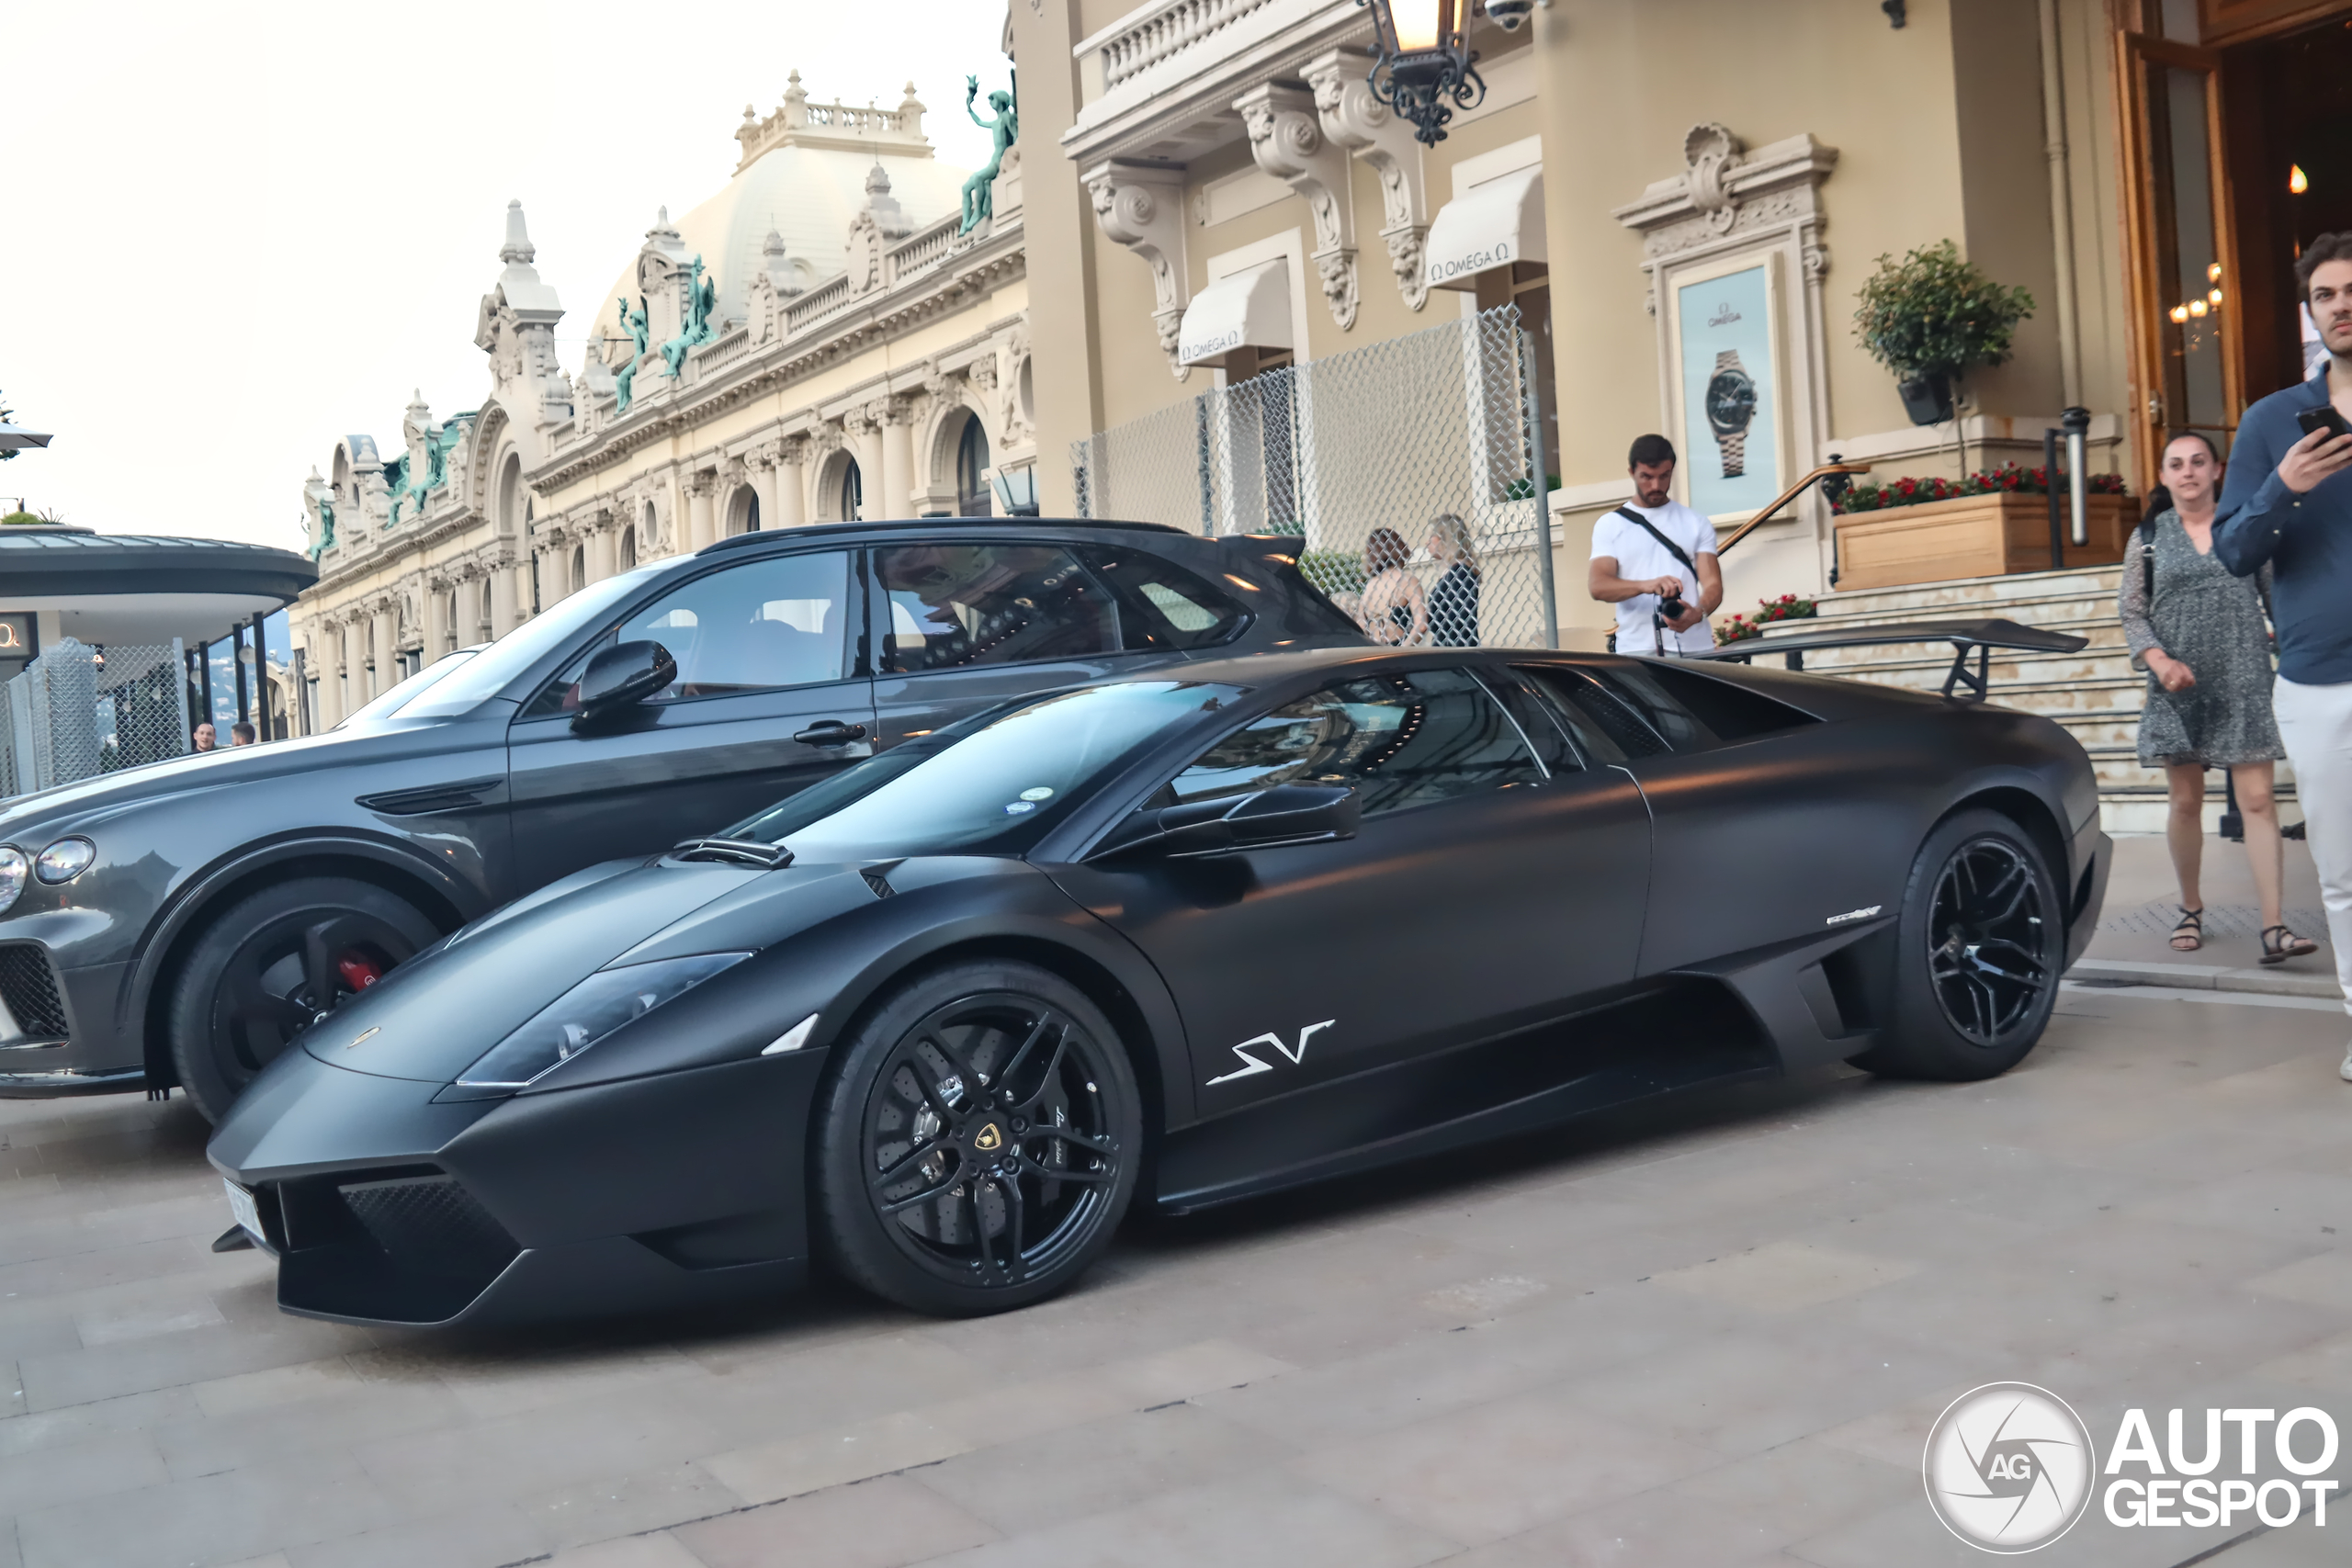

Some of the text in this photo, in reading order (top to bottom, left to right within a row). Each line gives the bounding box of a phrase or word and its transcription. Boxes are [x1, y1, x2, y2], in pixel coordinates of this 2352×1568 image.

[1445, 251, 1493, 276] OMEGA
[1708, 312, 1742, 328] OMEGA
[1193, 337, 1227, 357] OMEGA
[1205, 1019, 1336, 1086] SV
